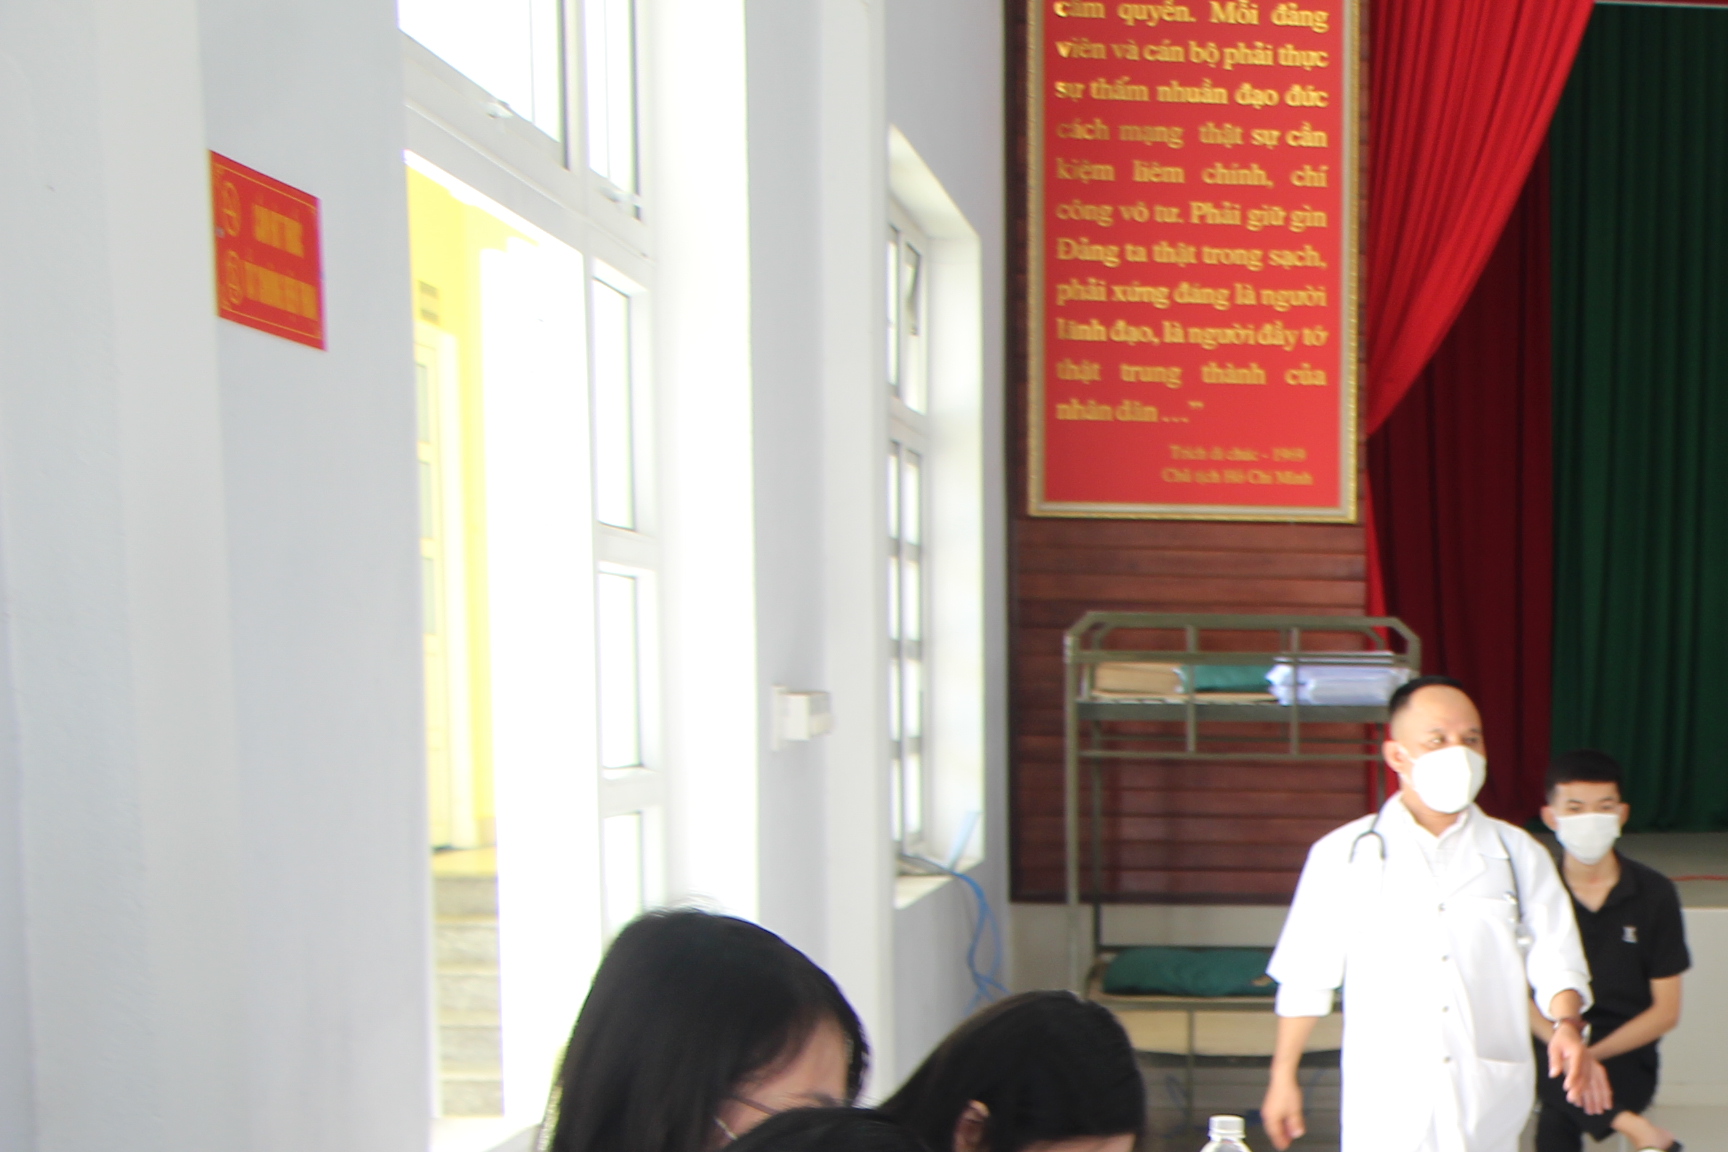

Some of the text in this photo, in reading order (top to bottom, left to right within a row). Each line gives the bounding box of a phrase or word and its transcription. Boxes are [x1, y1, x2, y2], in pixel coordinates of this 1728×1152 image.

[1124, 244, 1148, 262] ta
[1201, 245, 1264, 272] trong
[1120, 364, 1182, 389] trung
